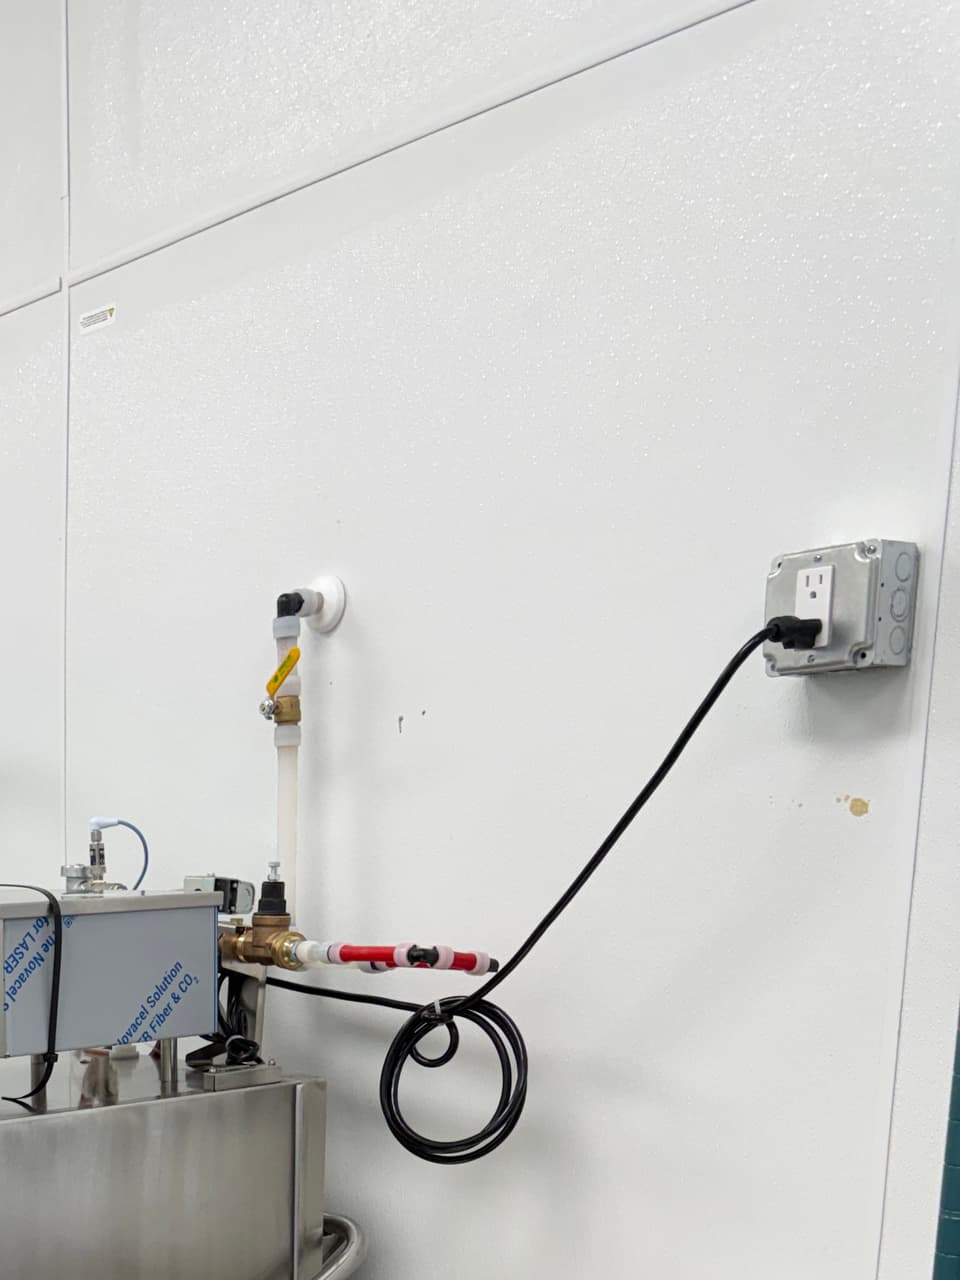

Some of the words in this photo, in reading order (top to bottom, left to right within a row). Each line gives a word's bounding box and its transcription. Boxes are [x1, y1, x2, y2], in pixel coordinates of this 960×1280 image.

[6, 952, 45, 1002] Novacel
[146, 961, 183, 1009] Solution
[149, 1002, 173, 1034] Fiber
[170, 992, 181, 1004] &
